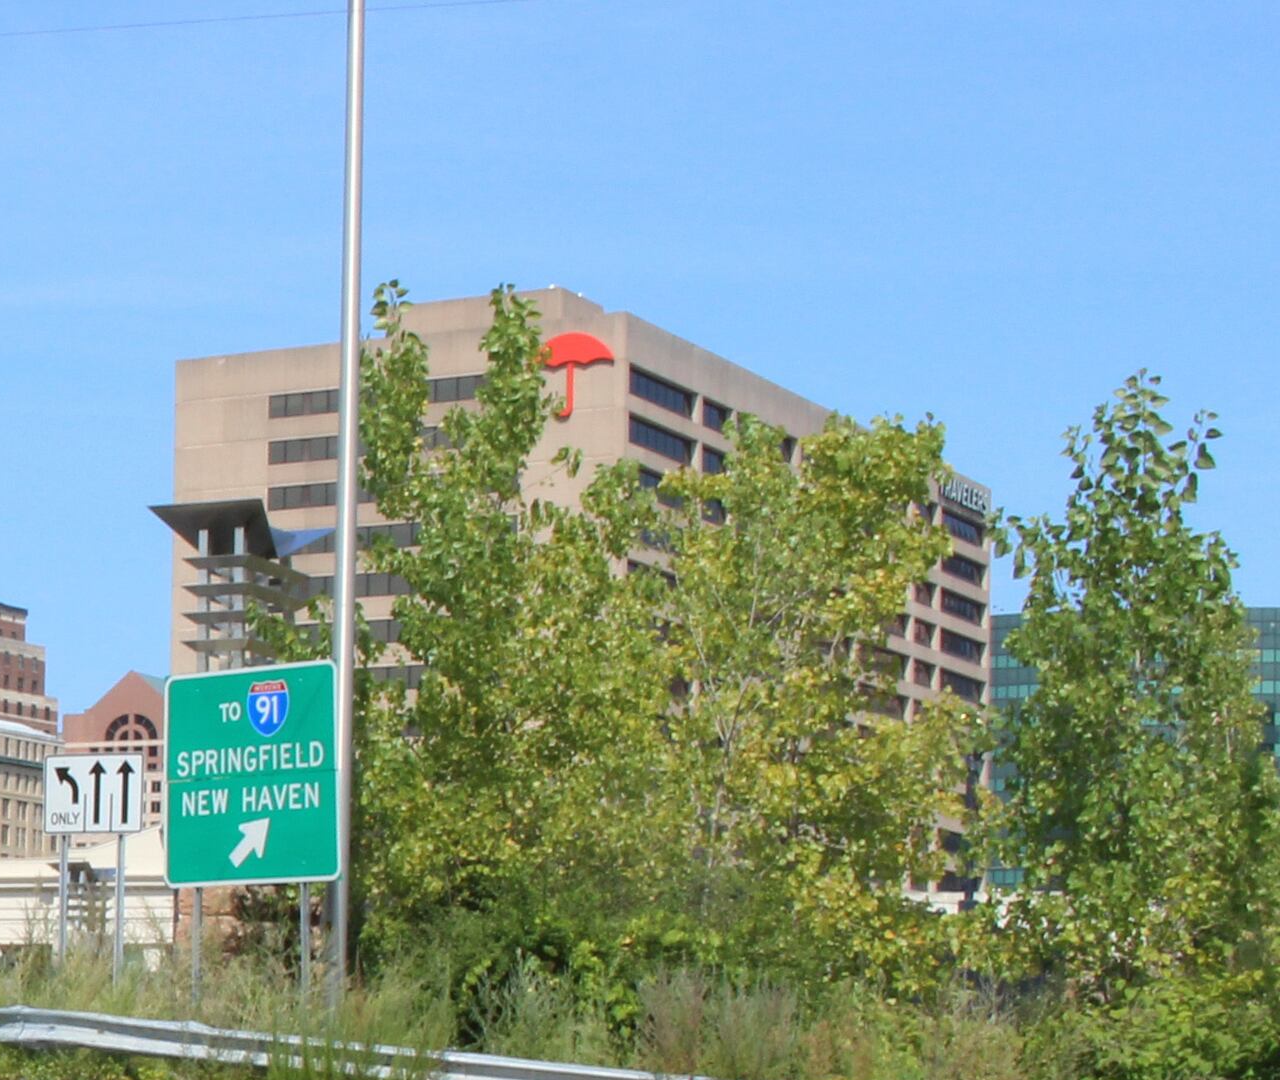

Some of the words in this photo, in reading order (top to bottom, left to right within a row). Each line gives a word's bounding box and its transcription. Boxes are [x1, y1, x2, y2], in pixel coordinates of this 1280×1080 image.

[219, 702, 241, 723] TO
[256, 695, 279, 724] 91
[177, 741, 324, 778] SPRINGFIELD
[181, 789, 228, 817] NEW
[242, 782, 320, 812] HAVEN
[51, 812, 80, 825] ONLY
